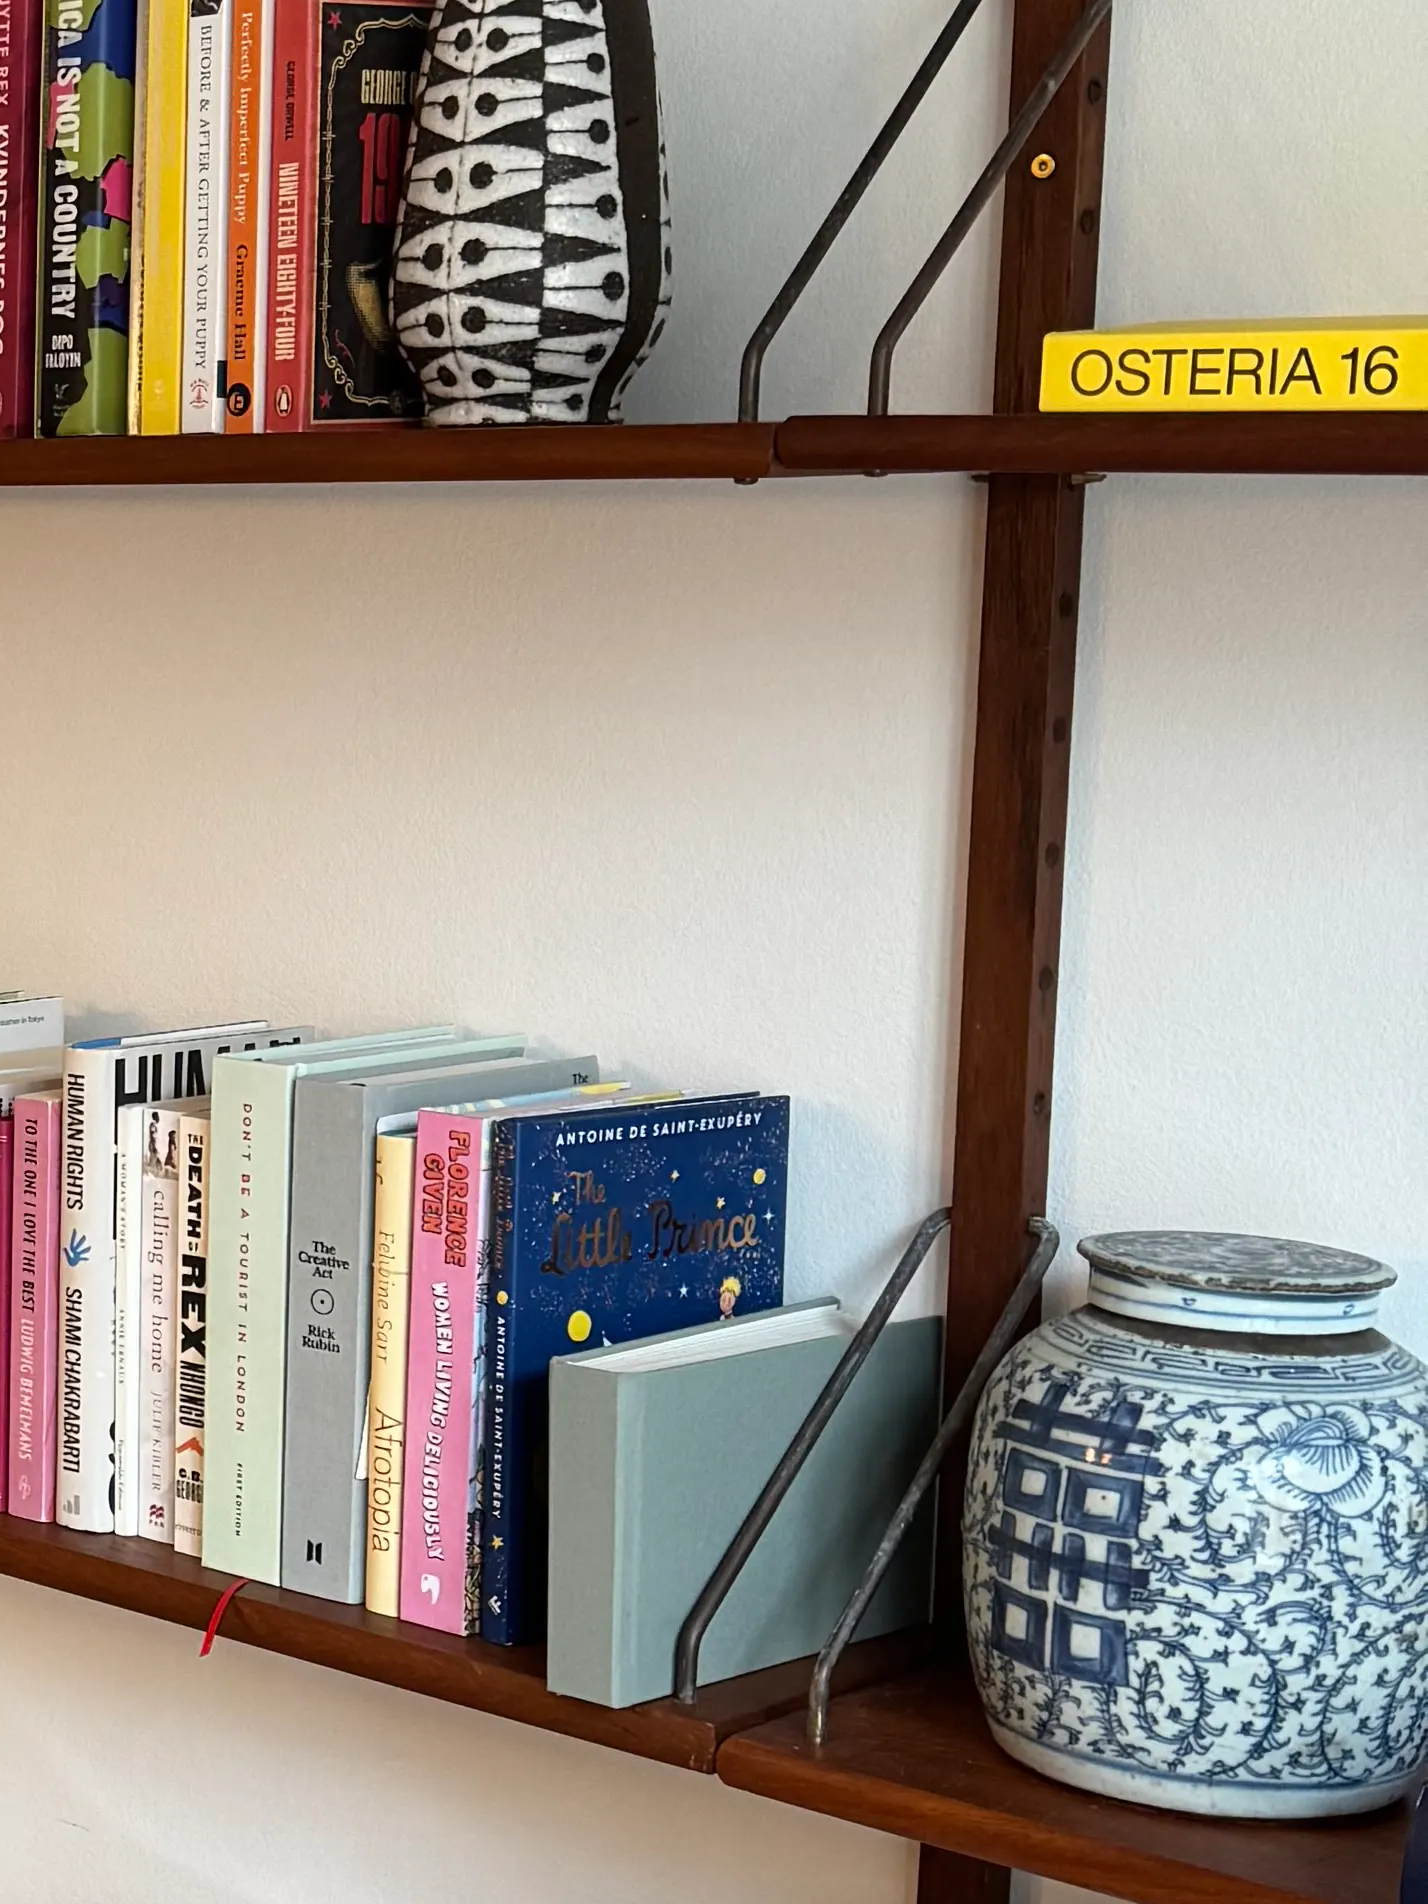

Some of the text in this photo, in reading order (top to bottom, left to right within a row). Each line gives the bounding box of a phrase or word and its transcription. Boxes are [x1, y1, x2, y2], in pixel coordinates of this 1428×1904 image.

[361, 68, 406, 105] GEORGE
[274, 162, 299, 362] NINETEEN EIGHTY-FOUR
[52, 335, 74, 351] DIPO
[1070, 344, 1400, 397] OSTERIA 16
[572, 1072, 589, 1085] The
[66, 1072, 84, 1211] HUMAN RIGHTS
[555, 1111, 762, 1147] ANTOINE DE SAINT-EXUPÉRY
[421, 1153, 445, 1235] GIVEN
[442, 1130, 472, 1269] FLORENCE
[568, 1170, 607, 1206] The
[298, 1251, 350, 1270] Creative
[311, 1240, 337, 1255] The
[540, 1201, 760, 1275] Little Prince
[313, 1265, 335, 1280] Act
[180, 1255, 206, 1357] REX
[307, 1324, 336, 1341] Rick
[301, 1336, 341, 1354] Rubin
[62, 1286, 82, 1473] SHAMI CHAKRABARTI
[179, 1361, 205, 1429] NHONGO
[421, 1281, 455, 1562] WOMEN LIVING DELICIOUSLY
[371, 1407, 403, 1554] Afrotopia
